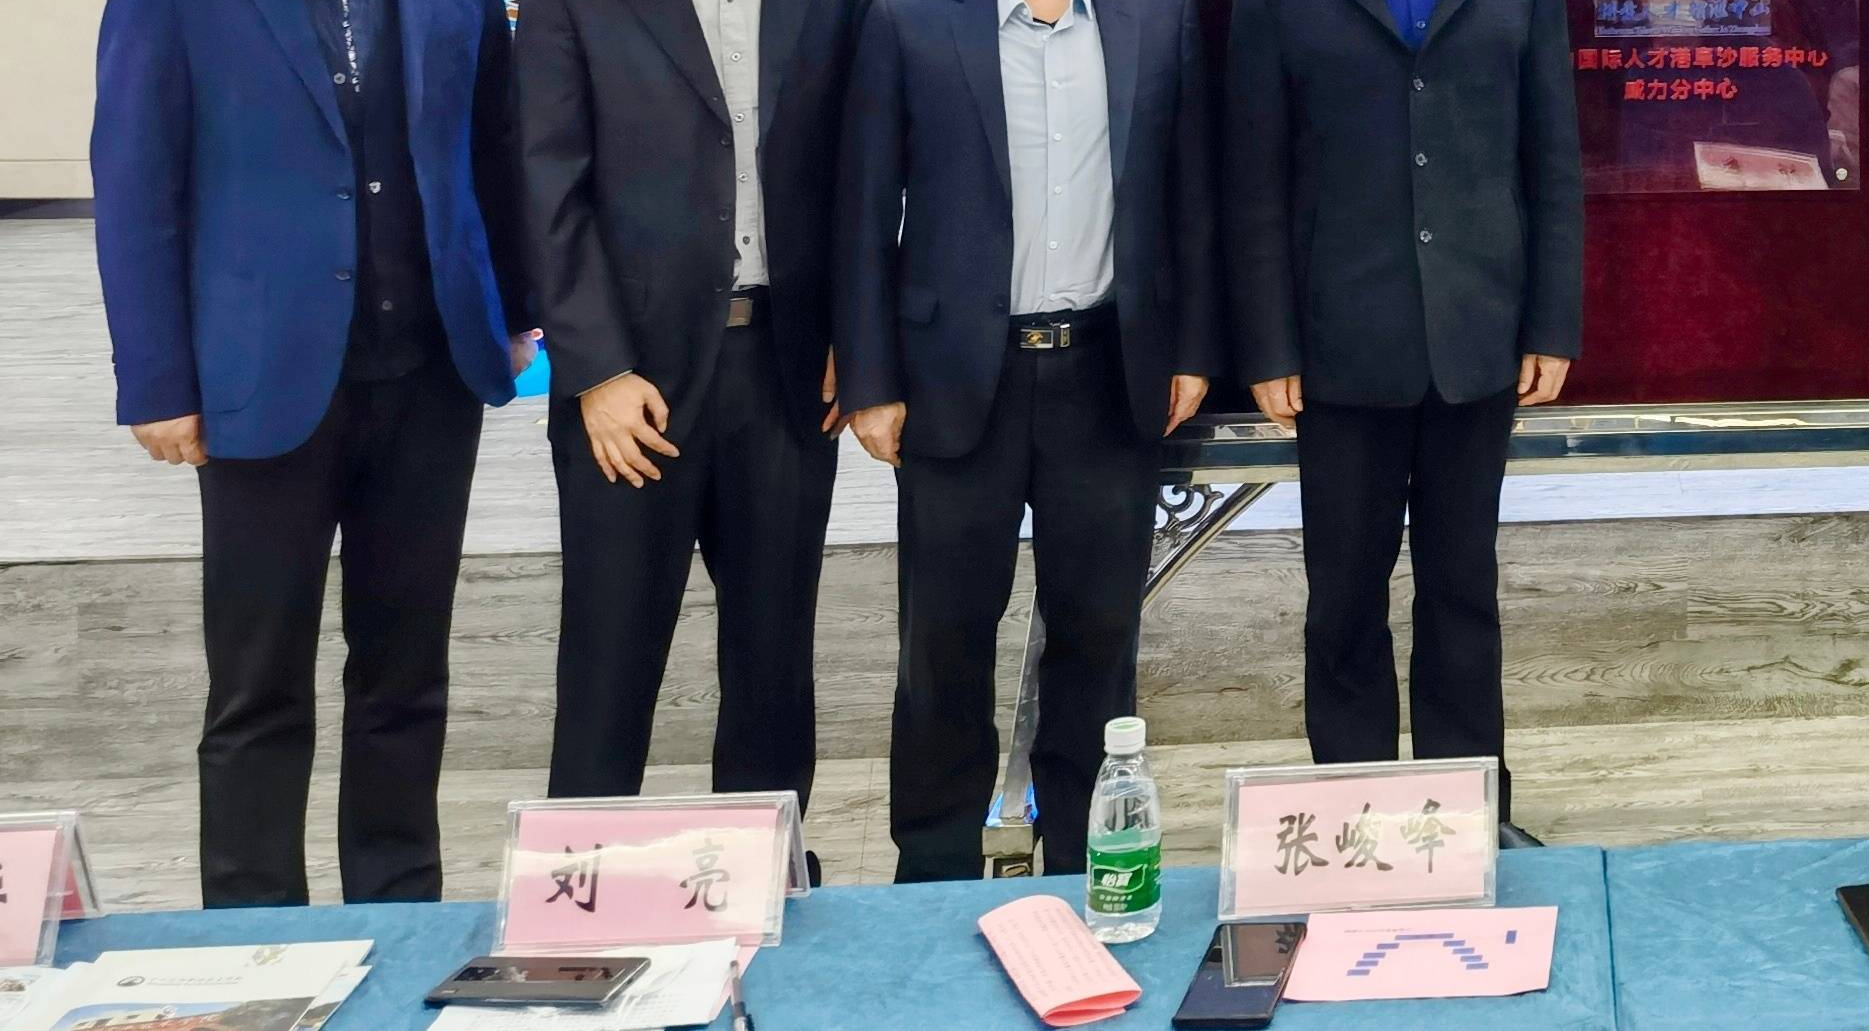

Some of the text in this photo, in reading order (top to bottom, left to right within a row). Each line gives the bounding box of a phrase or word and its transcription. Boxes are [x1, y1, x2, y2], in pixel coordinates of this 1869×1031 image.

[1570, 46, 1829, 70] 国际人才港阜沙服务中心
[545, 837, 731, 913] 刘亮
[1274, 798, 1458, 876] 张峻峰
